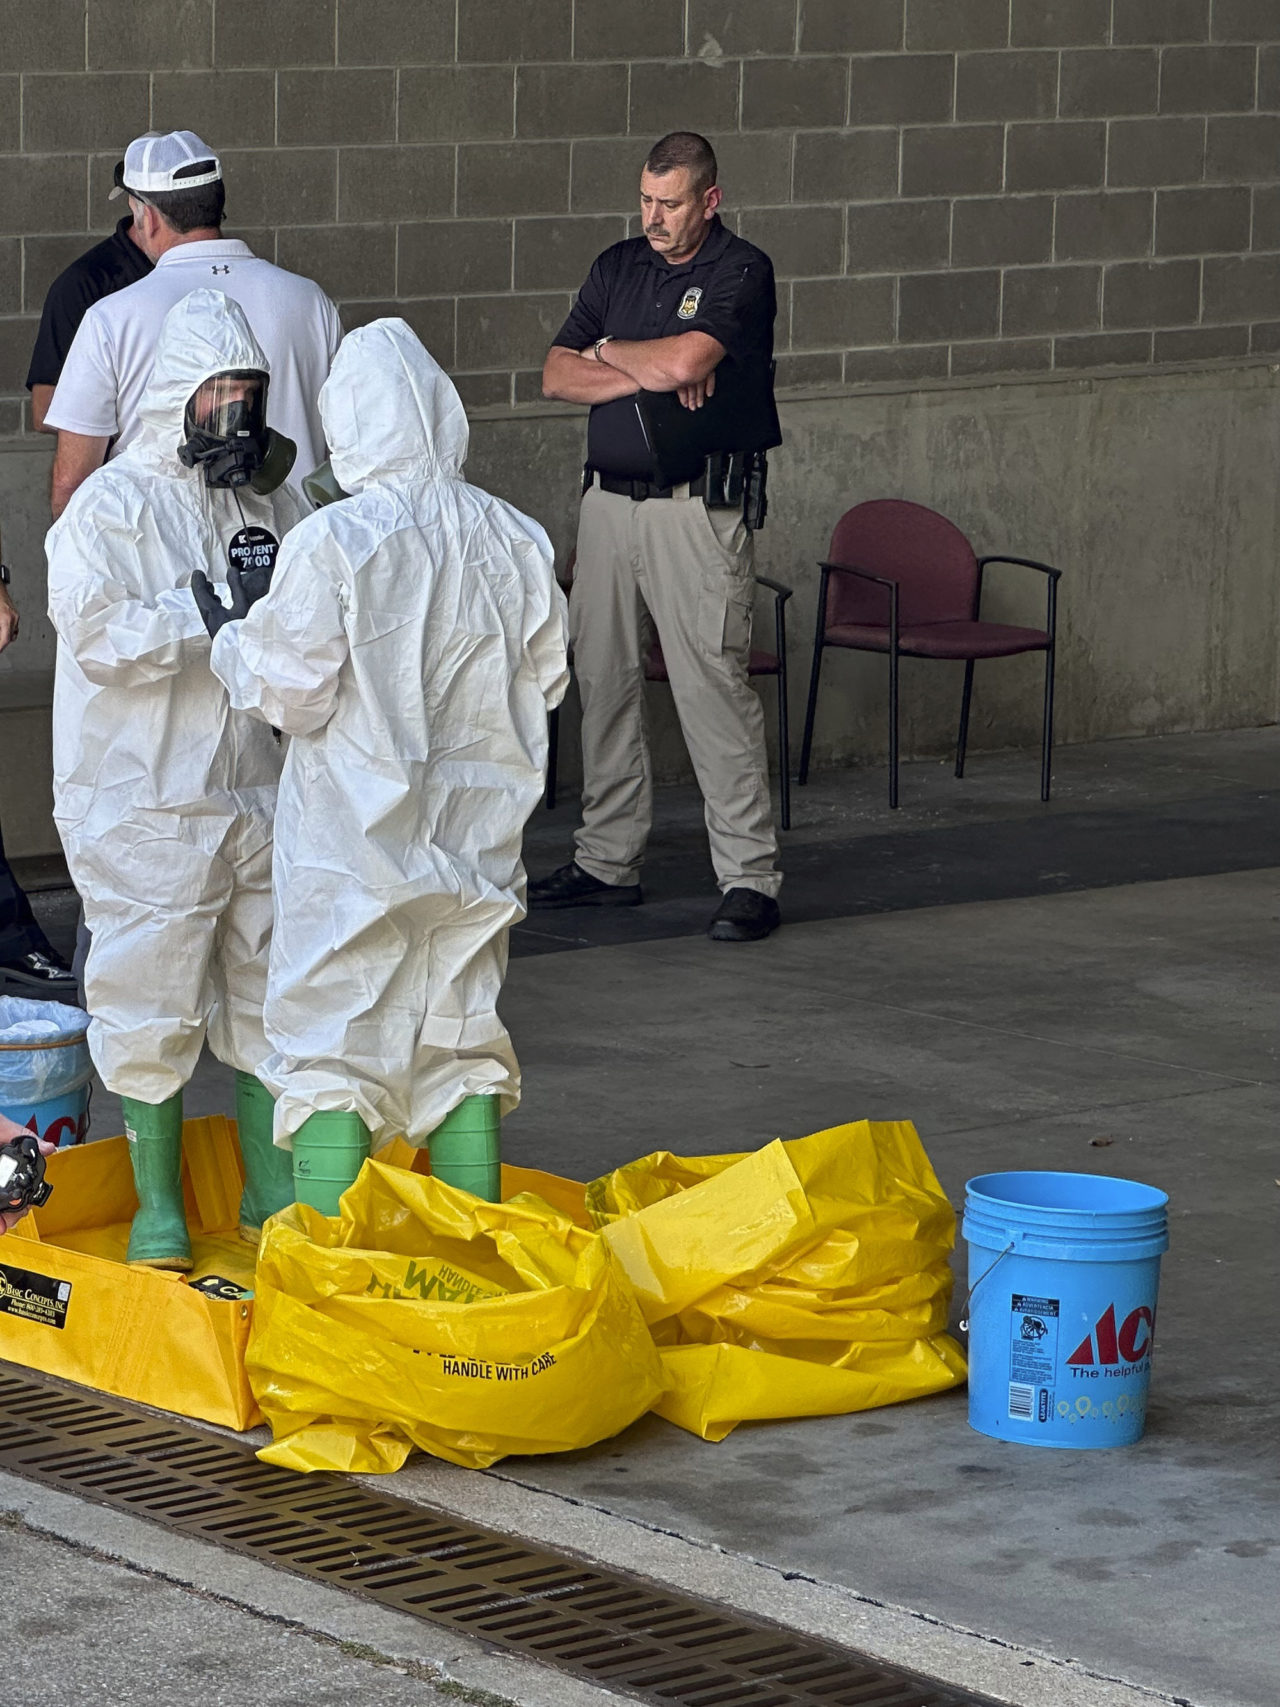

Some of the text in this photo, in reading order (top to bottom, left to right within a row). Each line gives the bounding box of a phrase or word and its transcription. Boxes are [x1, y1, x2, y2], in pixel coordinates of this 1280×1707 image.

[443, 1359, 492, 1380] HANDLE
[495, 1365, 529, 1381] WITH
[531, 1351, 558, 1376] CARE
[1070, 1366, 1099, 1379] The
[1104, 1360, 1144, 1380] helpful
